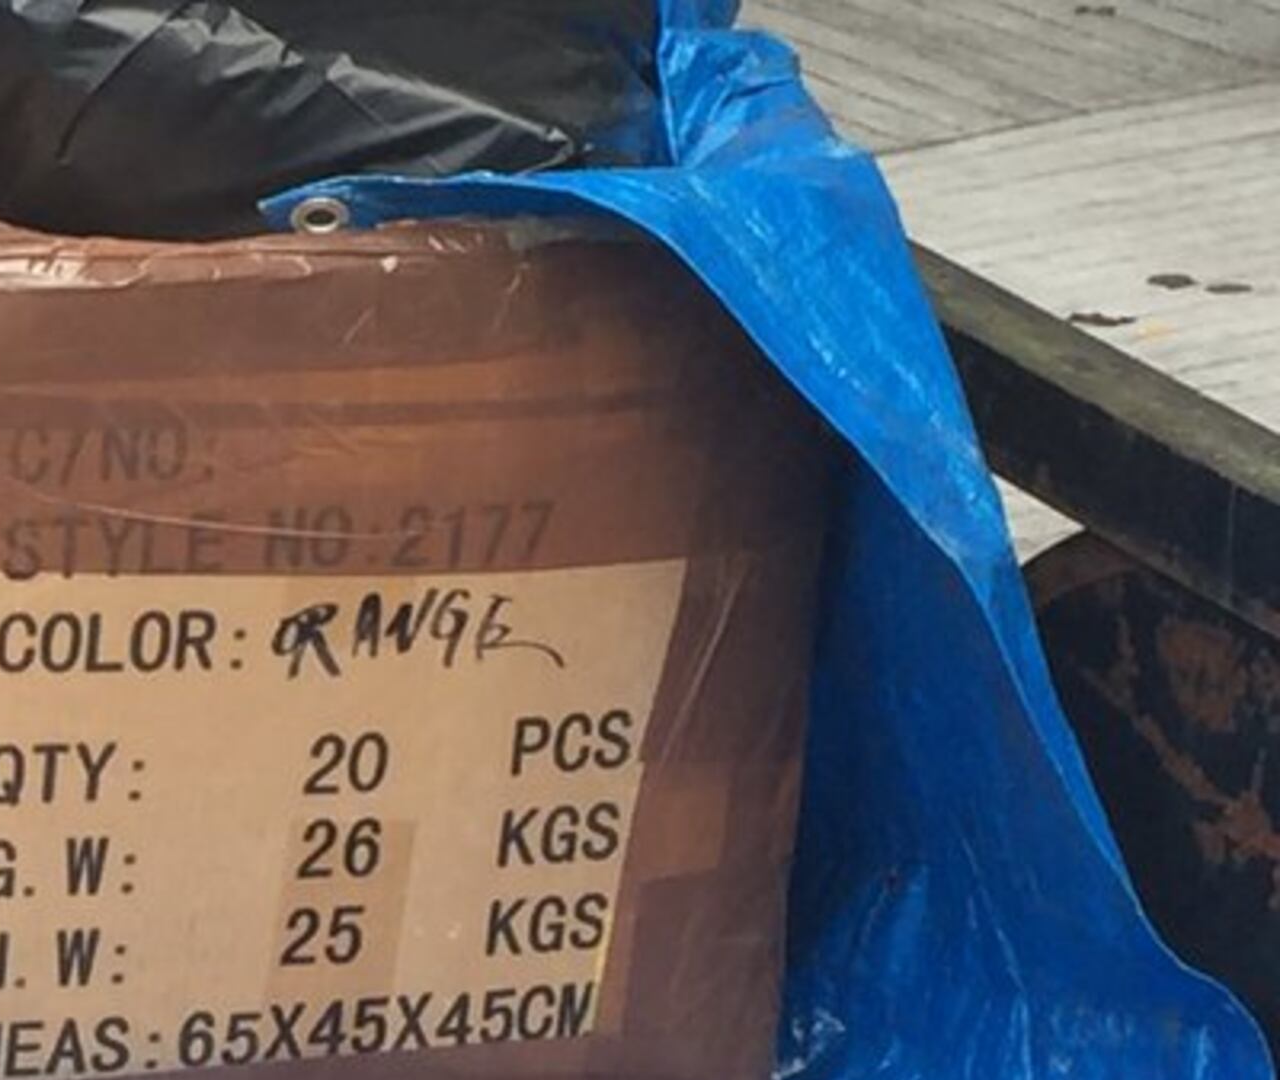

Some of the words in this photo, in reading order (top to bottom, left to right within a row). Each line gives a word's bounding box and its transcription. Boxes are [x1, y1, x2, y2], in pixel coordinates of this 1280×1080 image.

[2, 507, 224, 581] STYLE
[271, 587, 566, 680] ORANGE
[303, 732, 389, 794] 20
[510, 709, 633, 776] PCS
[296, 818, 382, 879] 26
[497, 801, 620, 867] KGS
[280, 906, 366, 967] 25
[485, 892, 608, 956] KGS
